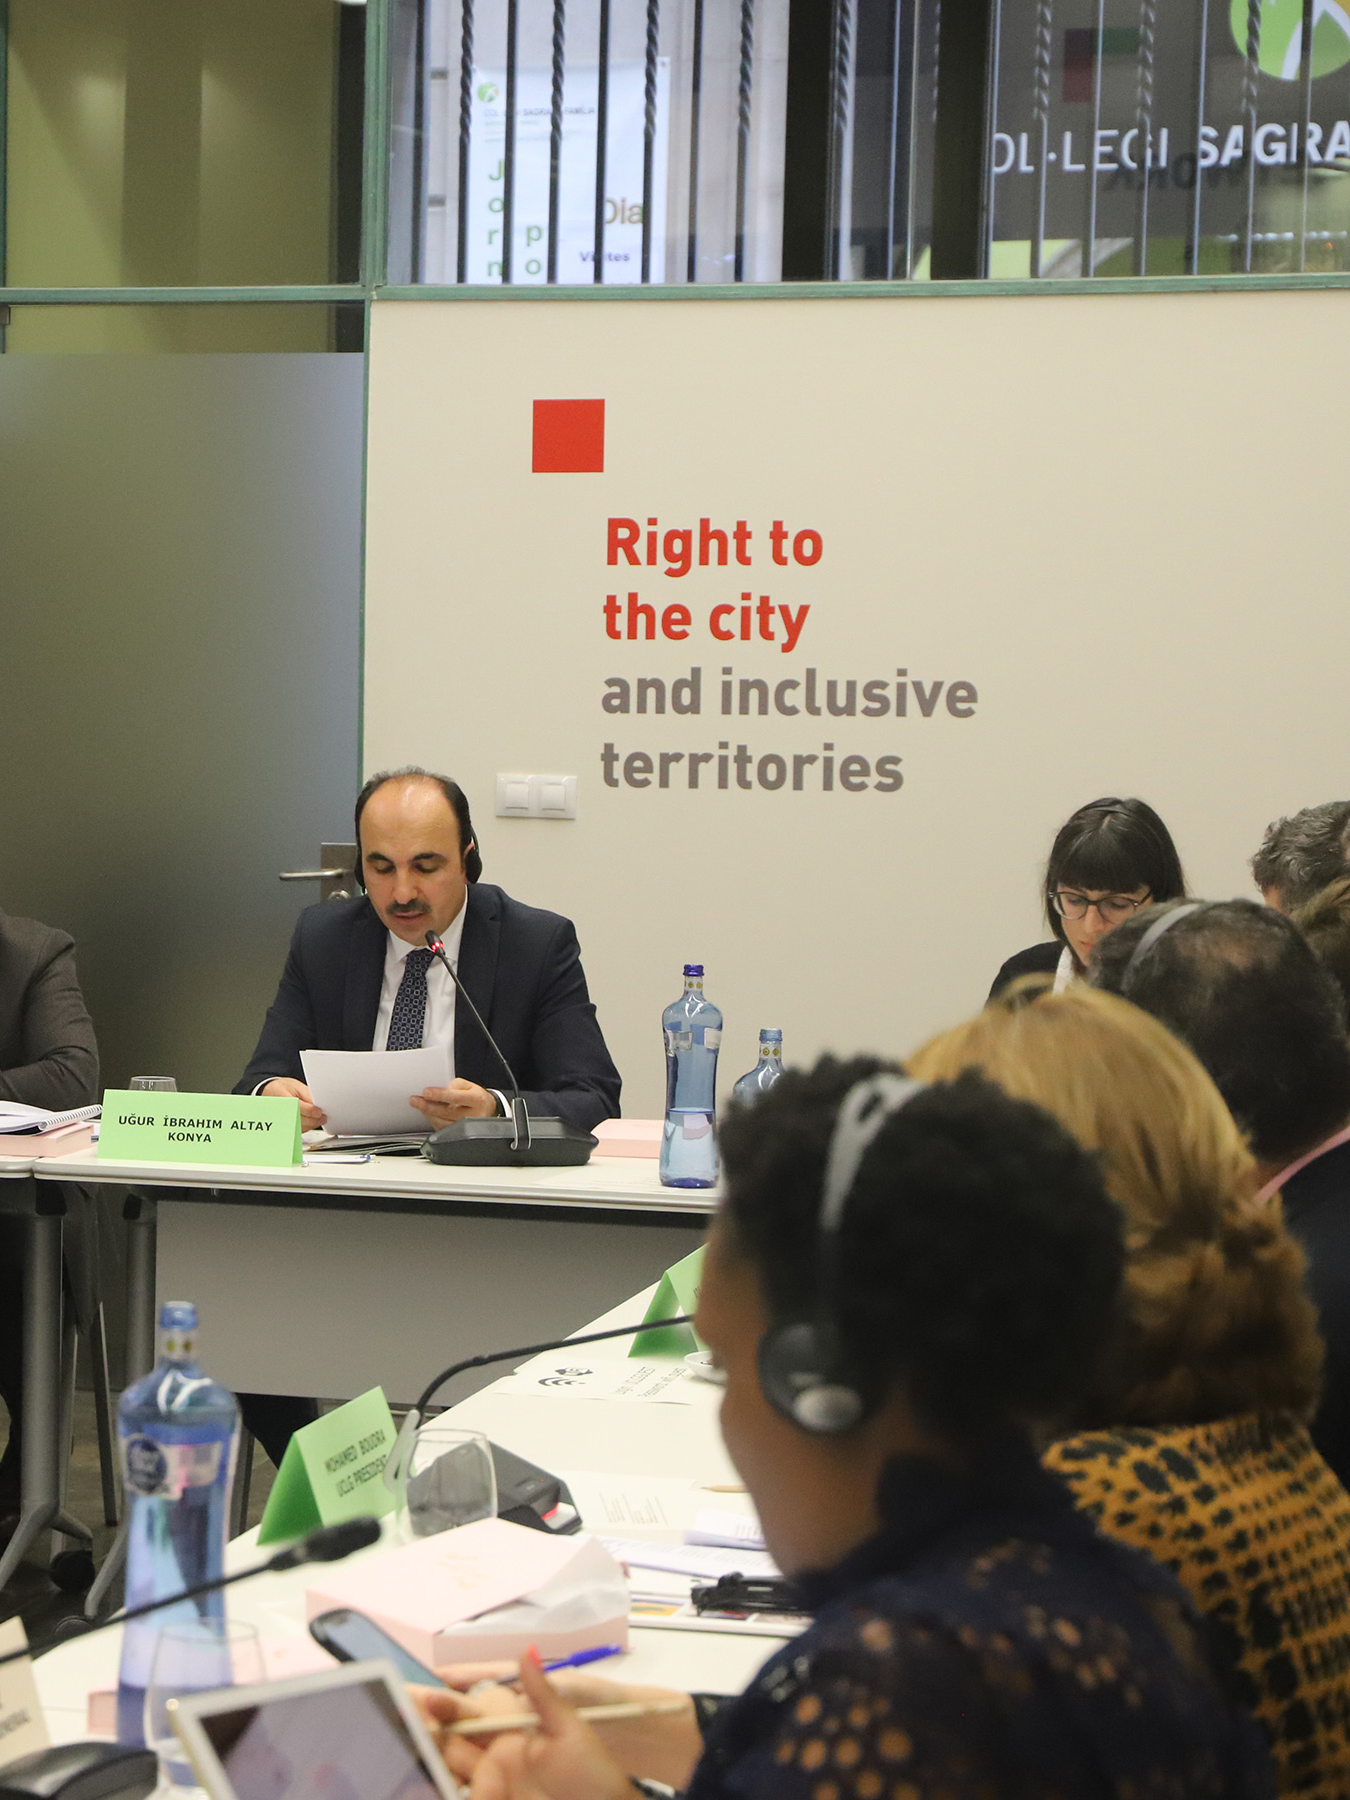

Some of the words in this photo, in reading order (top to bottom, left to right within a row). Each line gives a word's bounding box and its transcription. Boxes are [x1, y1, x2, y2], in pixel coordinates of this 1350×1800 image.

[606, 517, 752, 578] Right
[768, 520, 824, 567] to
[602, 591, 692, 641] the
[708, 591, 811, 653] city
[601, 666, 703, 716] and
[720, 666, 979, 719] inclusive
[600, 740, 905, 793] territories
[118, 1113, 156, 1127] UĞUR
[162, 1114, 223, 1130] İBRAHIM
[230, 1119, 274, 1132] ALTAY
[167, 1131, 213, 1144] KONYA
